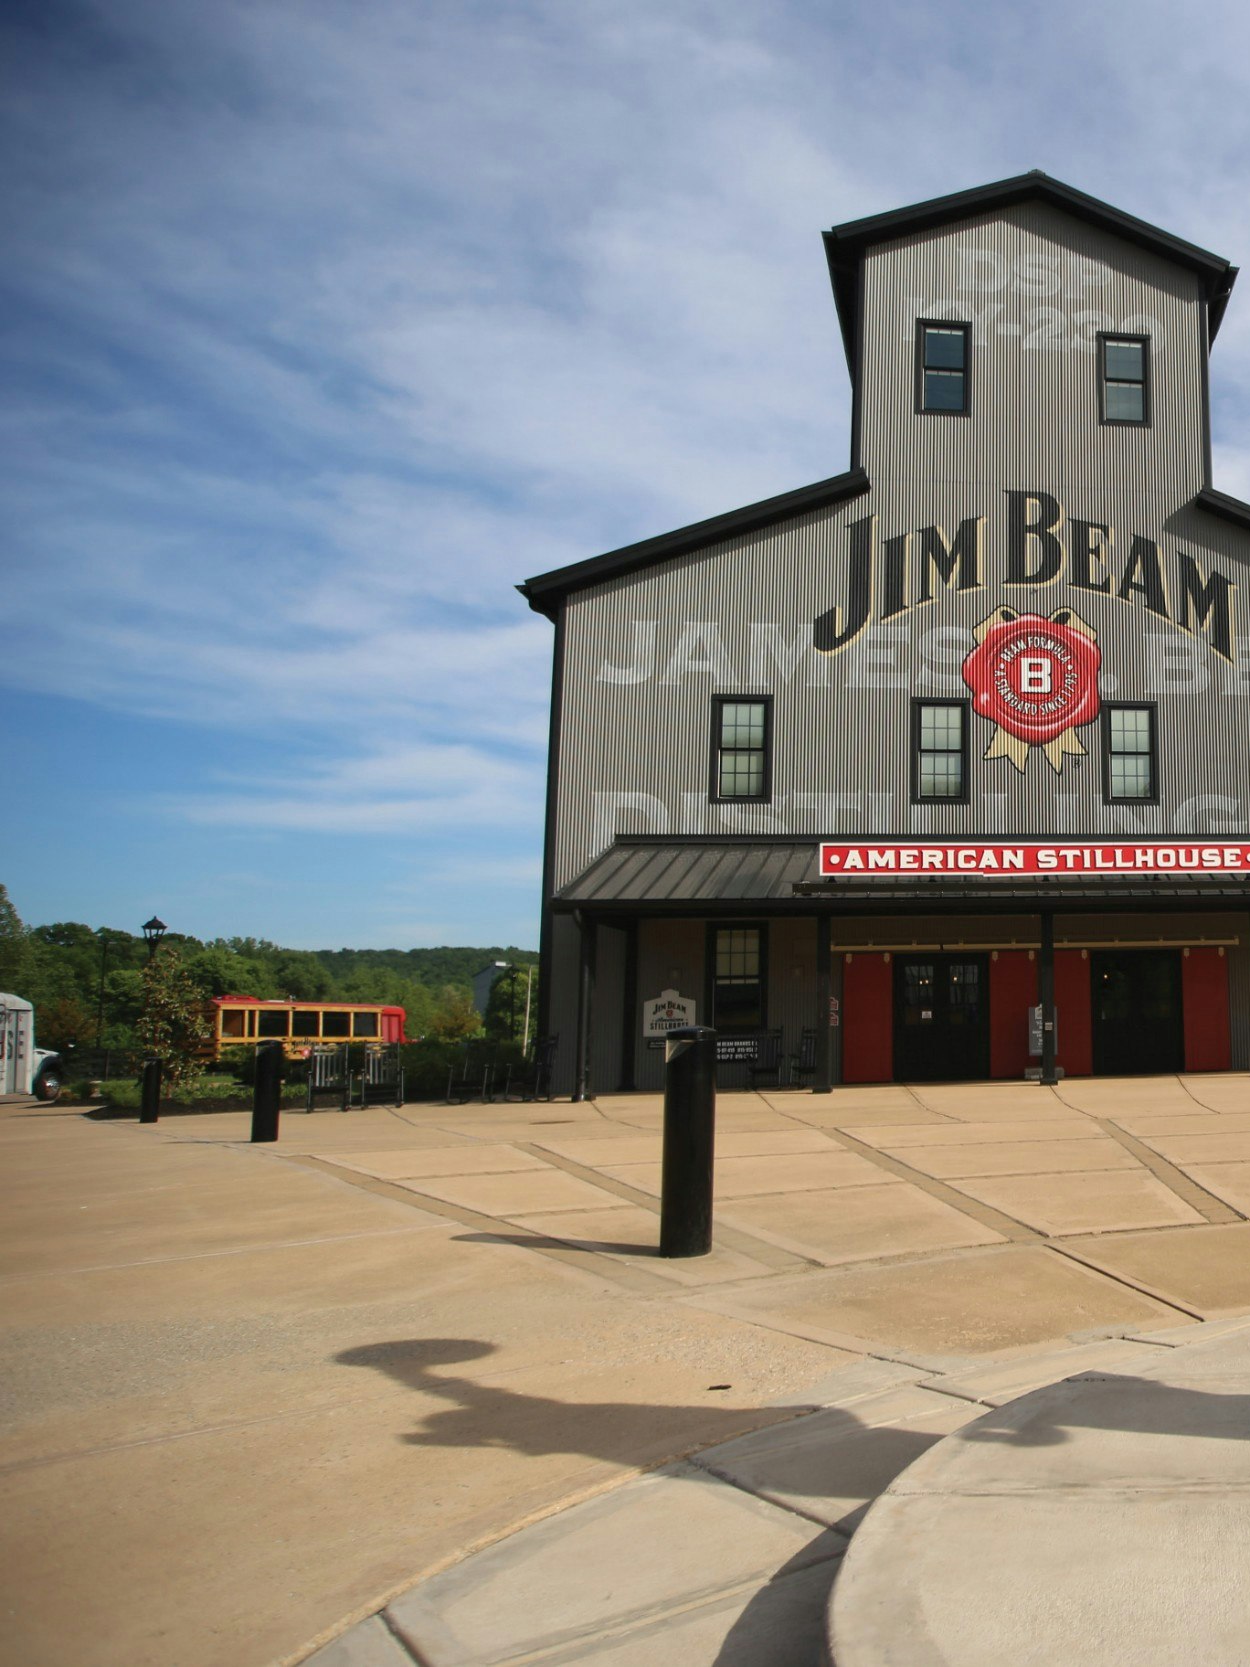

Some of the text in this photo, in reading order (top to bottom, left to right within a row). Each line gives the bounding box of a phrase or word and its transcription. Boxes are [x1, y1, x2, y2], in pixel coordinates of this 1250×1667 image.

[957, 248, 1113, 300] DSP
[813, 489, 1239, 665] JIM BEAM
[594, 620, 972, 689] JAMES
[1001, 636, 1071, 664] BEAM FORMULA
[1020, 657, 1052, 693] B
[994, 678, 1038, 716] STANDARD
[1040, 694, 1067, 716] SINCE
[842, 847, 1242, 870] AMERICAN STILLHOUSE
[653, 1000, 687, 1015] JIM BEAM
